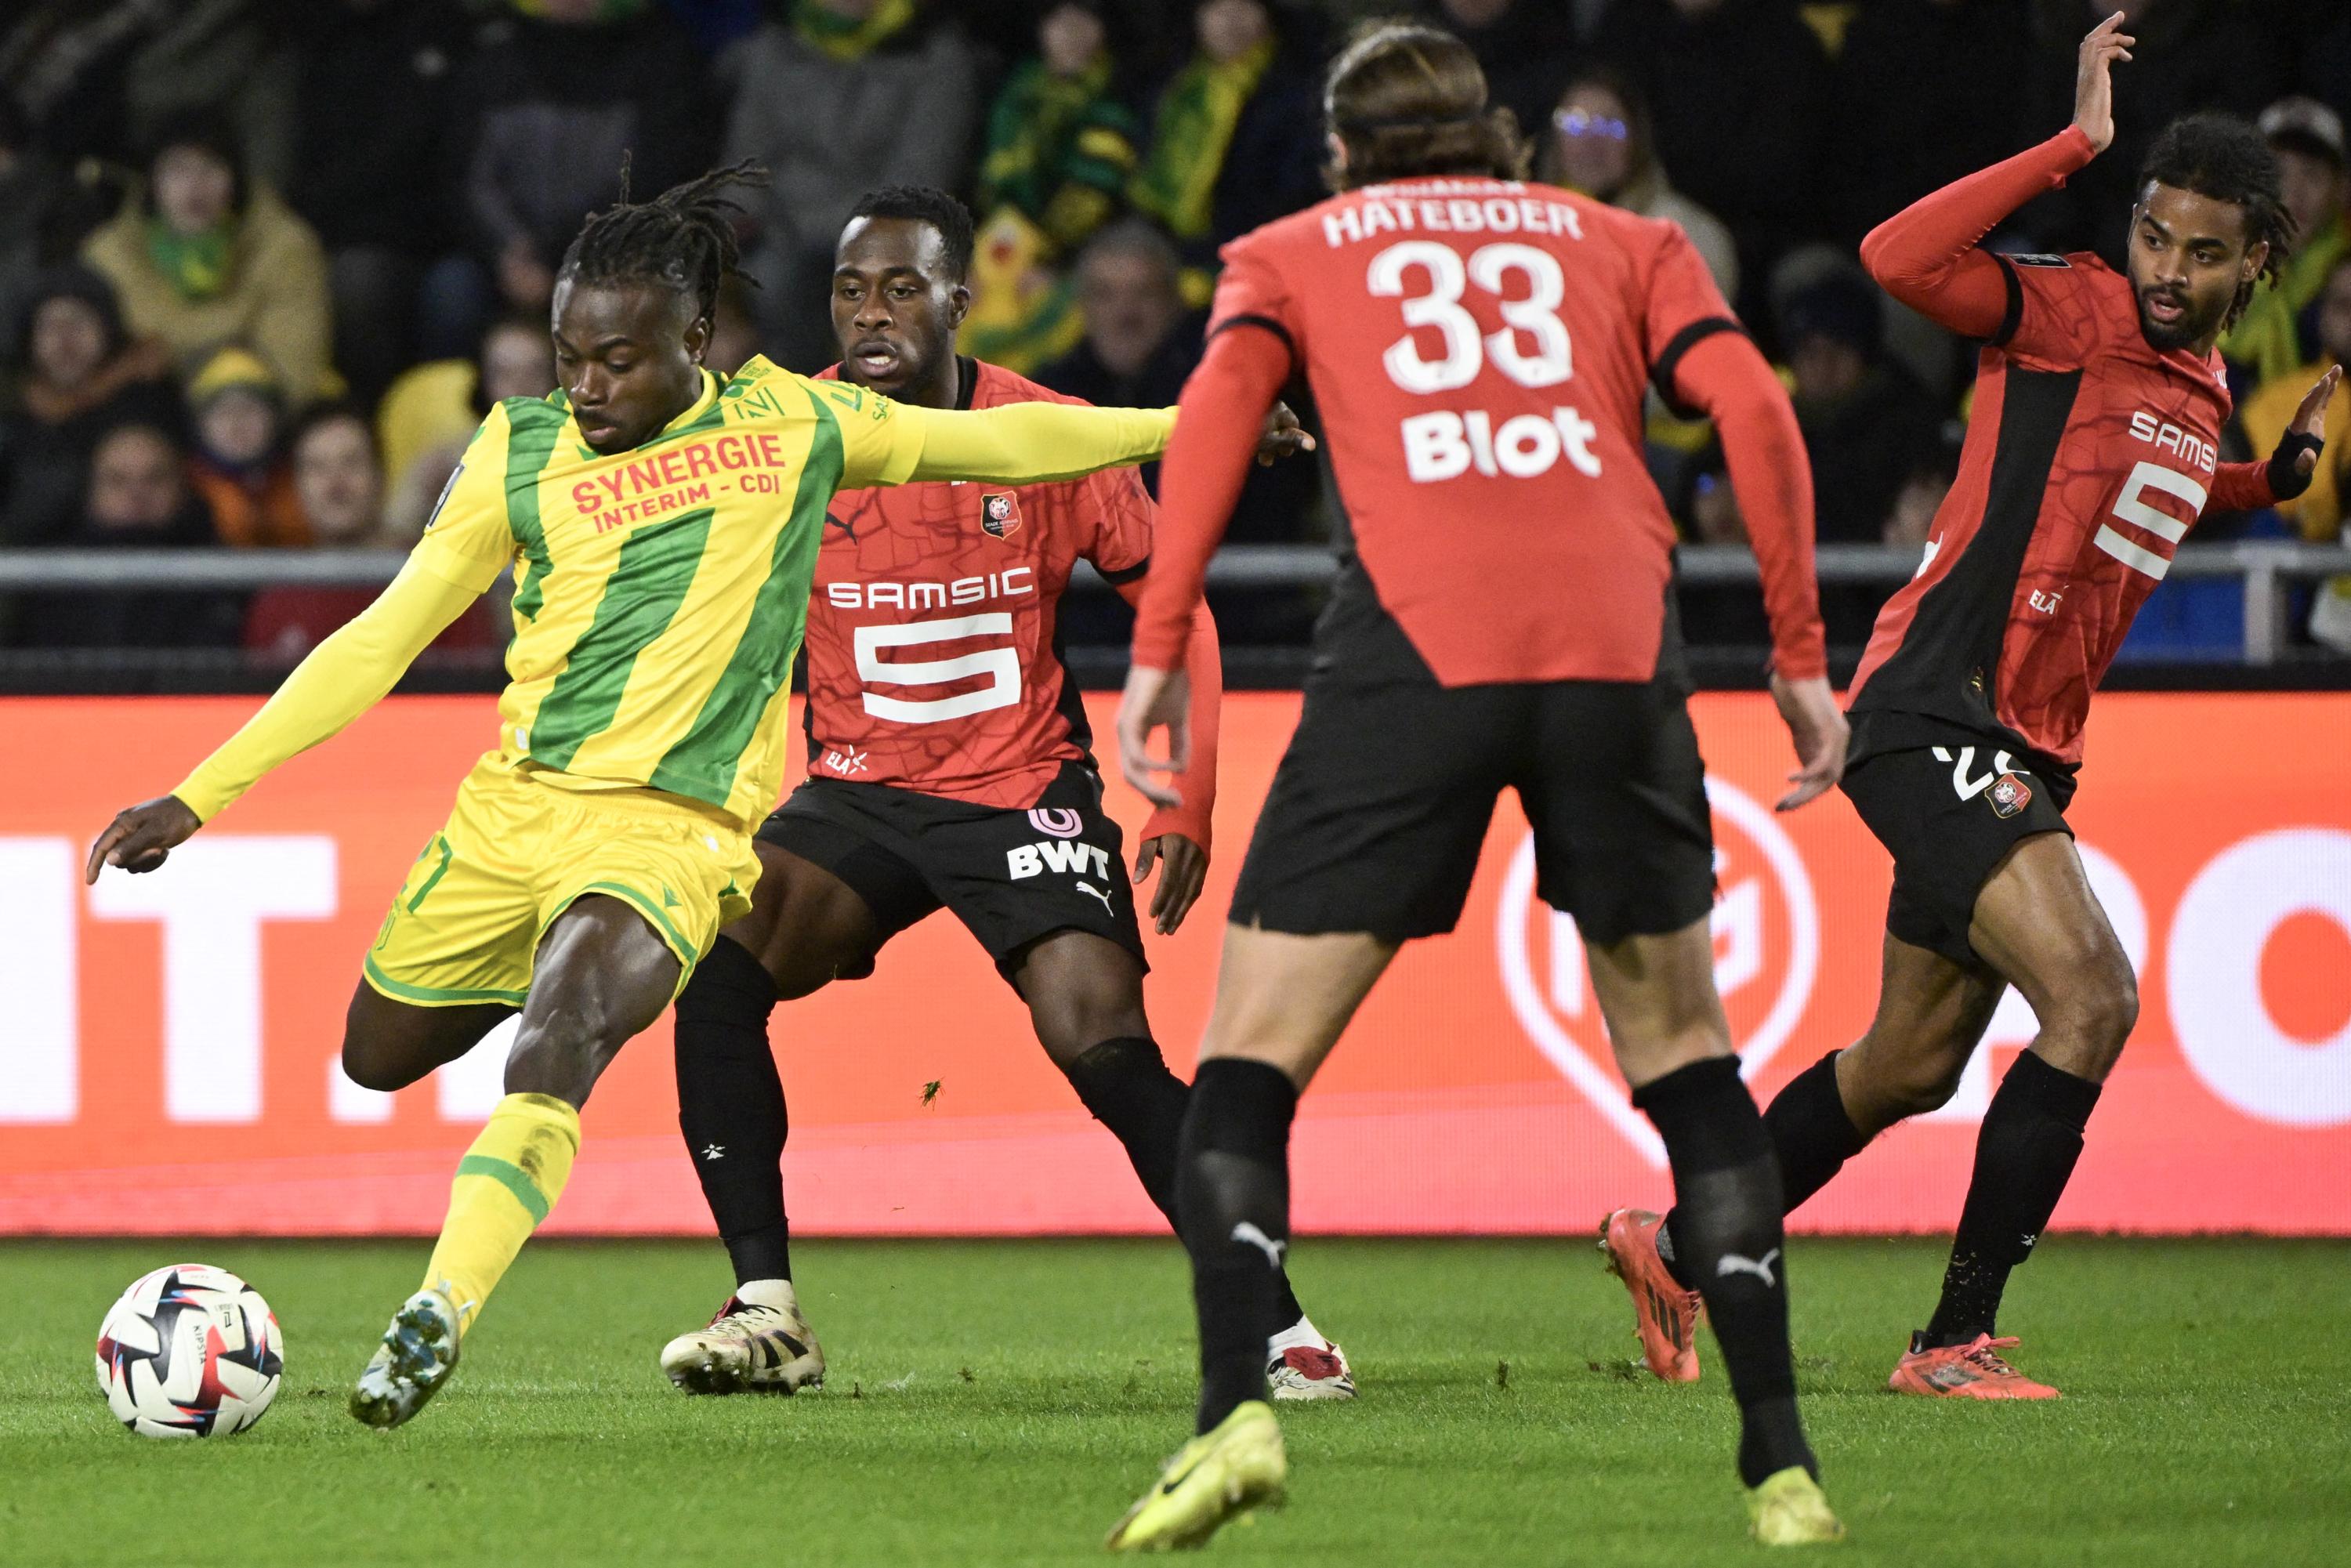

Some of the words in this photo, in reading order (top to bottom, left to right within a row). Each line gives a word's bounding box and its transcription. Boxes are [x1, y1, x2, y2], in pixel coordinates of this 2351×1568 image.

[1322, 197, 1585, 248] HATEBOER
[1366, 240, 1574, 395] 33
[1400, 405, 1602, 483] Blot
[571, 434, 785, 514] SYNERGIE
[592, 488, 711, 534] INTERIM
[740, 472, 781, 495] CDI
[827, 566, 1034, 610] SAMSIC
[2029, 588, 2056, 615] ELA
[825, 751, 851, 775] ELA
[1006, 839, 1110, 881] BWT
[193, 1324, 207, 1364] KIPSTA
